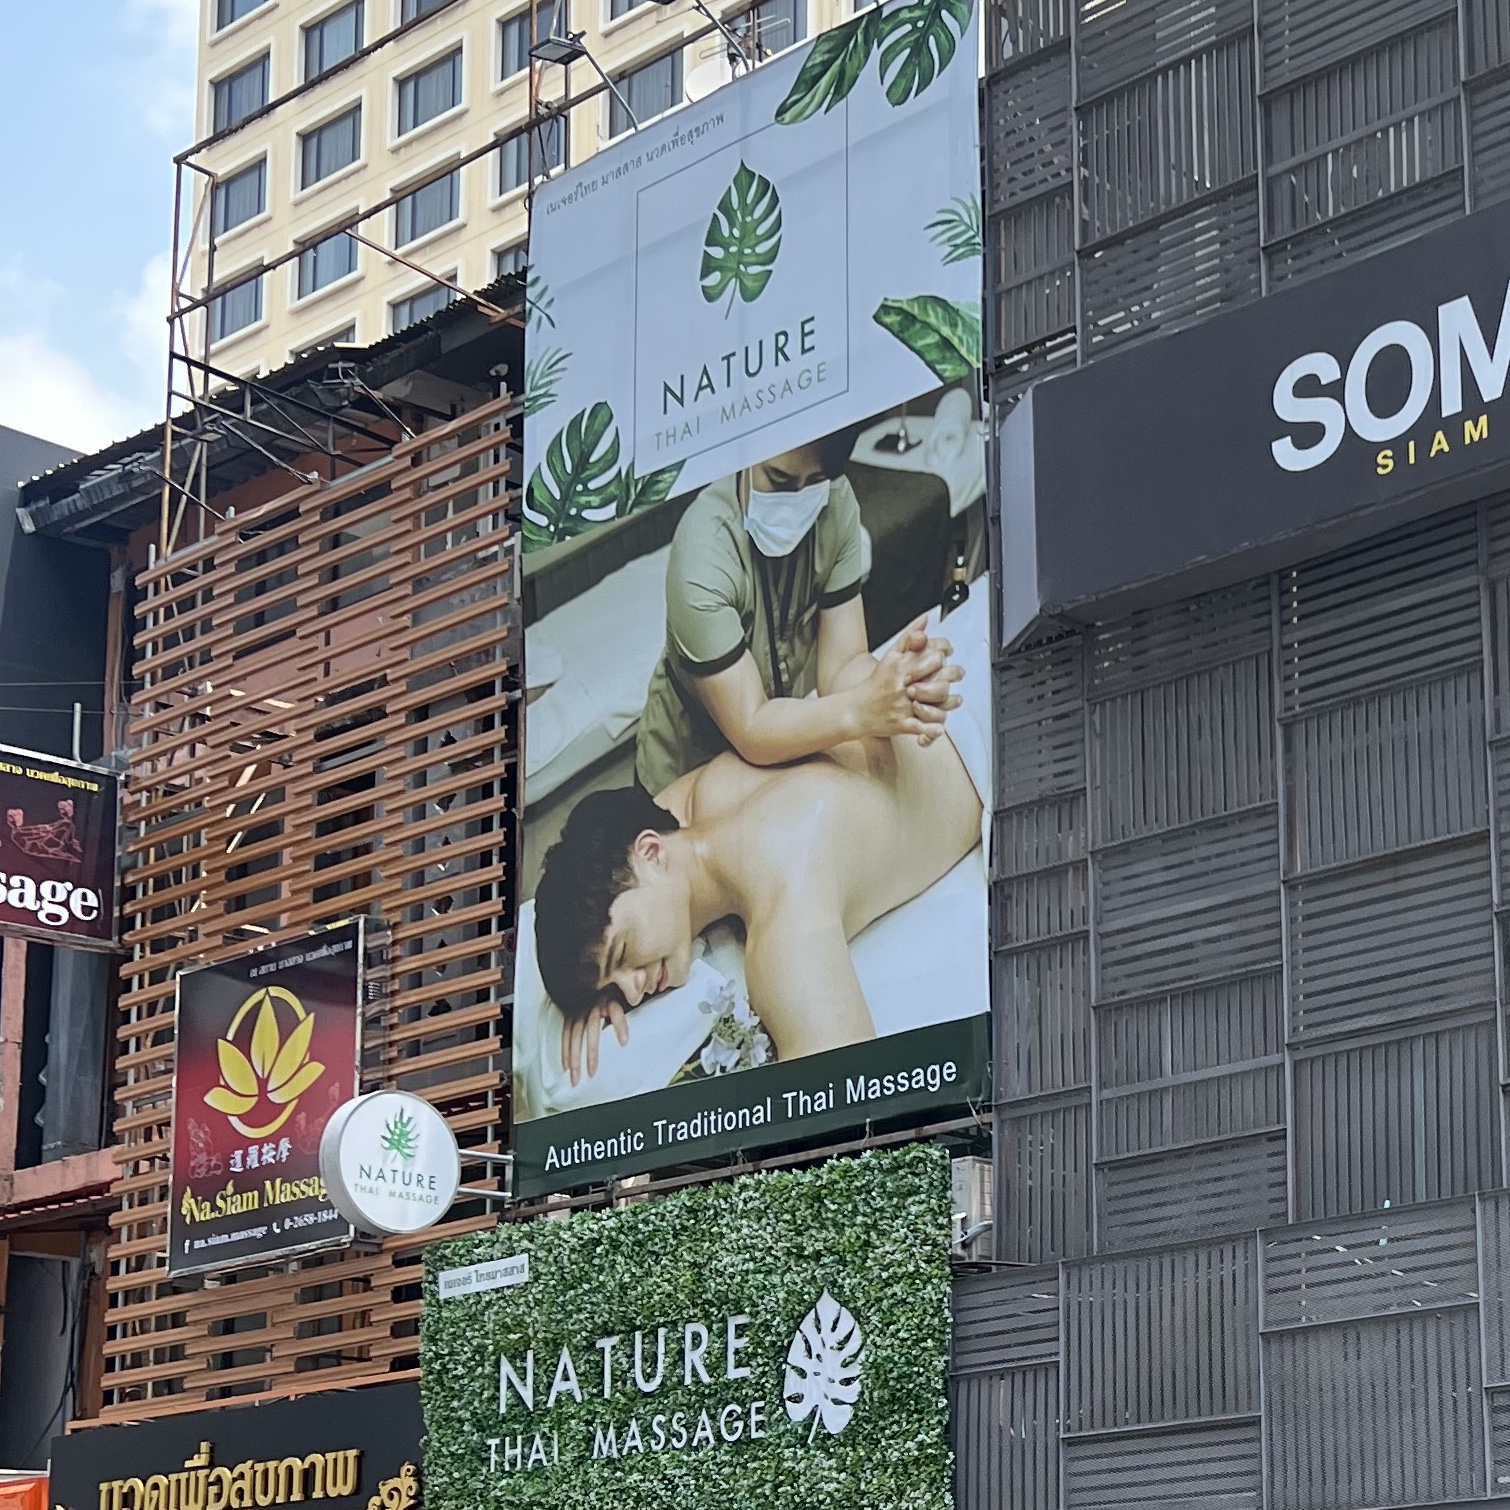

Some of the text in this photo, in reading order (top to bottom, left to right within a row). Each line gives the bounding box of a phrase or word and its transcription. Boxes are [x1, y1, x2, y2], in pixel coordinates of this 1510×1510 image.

[661, 315, 817, 415] NATURE
[654, 361, 829, 452] THAI MASSAGE
[1374, 413, 1490, 476] SIAM
[544, 1058, 958, 1171] Authentic Traditional Thai Massage
[264, 1175, 328, 1208] Massag
[354, 1183, 440, 1205] THAI MASSAGE
[358, 1164, 437, 1191] NATURE
[498, 1313, 753, 1415] NATURE
[486, 1401, 767, 1473] THAI MASSAGE
